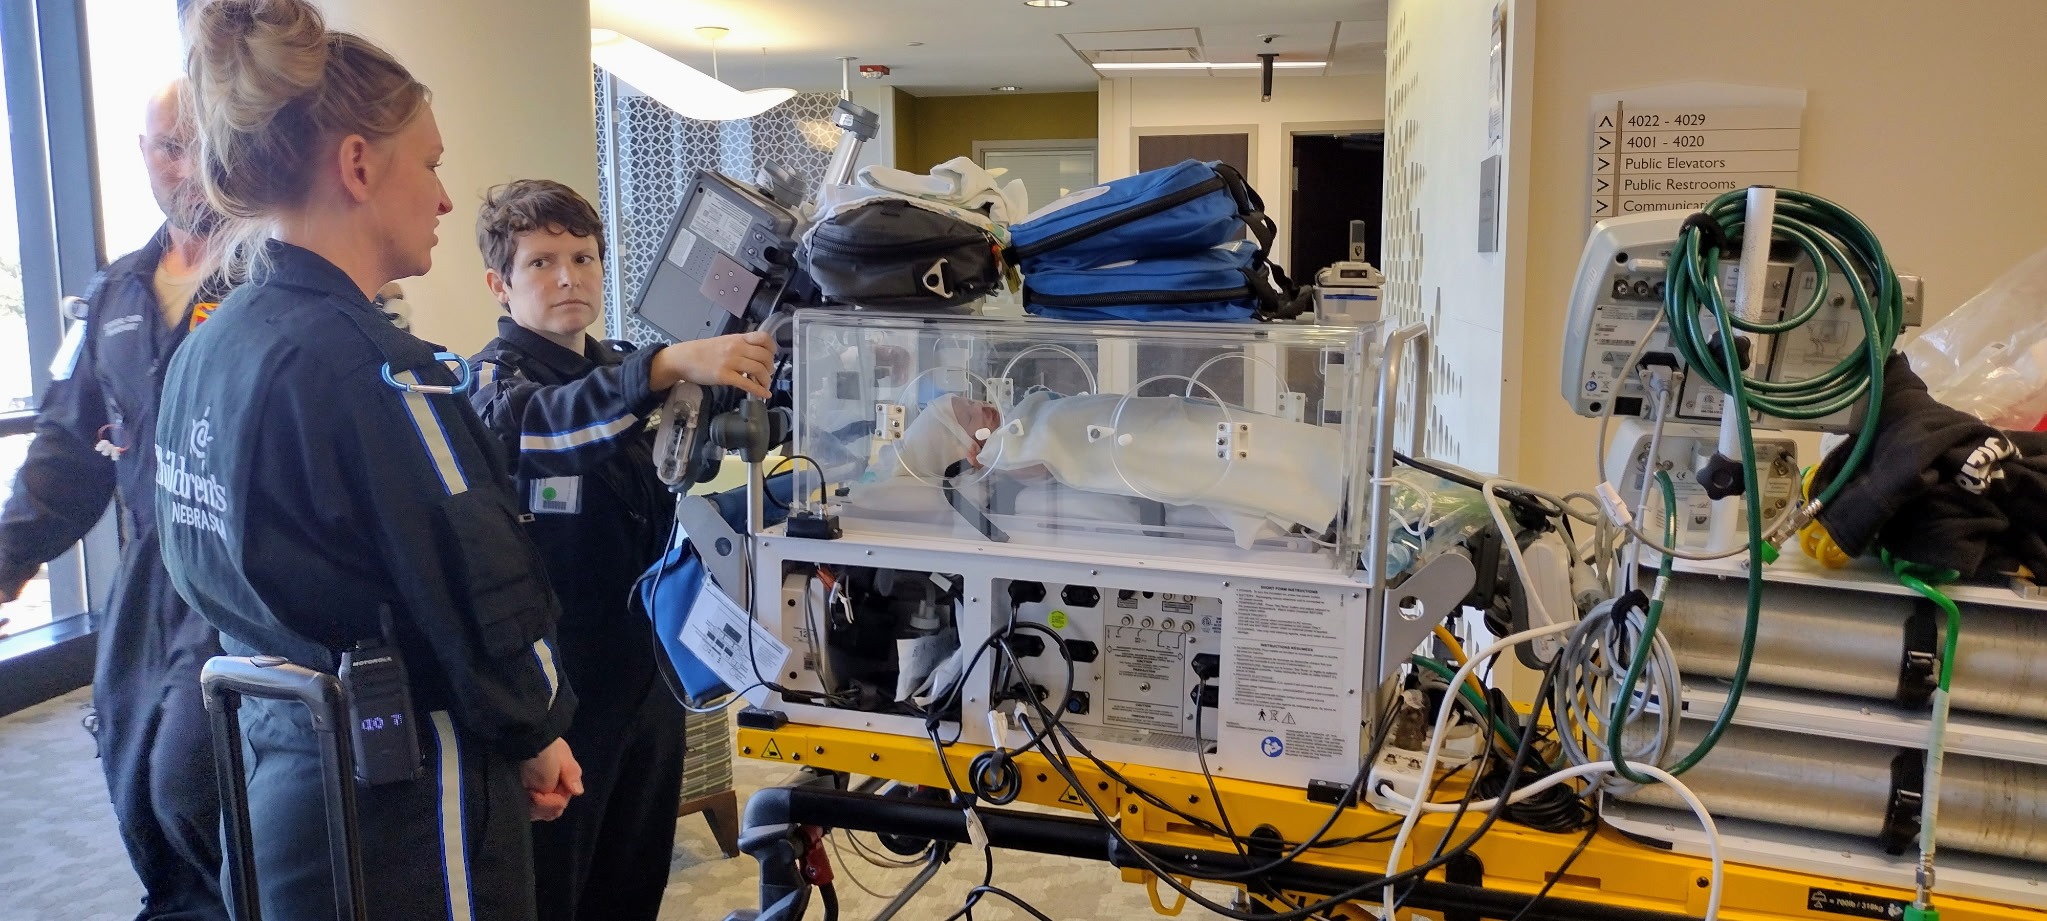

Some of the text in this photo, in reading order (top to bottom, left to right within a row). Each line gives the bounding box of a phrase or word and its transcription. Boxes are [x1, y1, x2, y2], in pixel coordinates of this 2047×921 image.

[1628, 115, 1660, 127] 4022
[1674, 114, 1706, 127] 4029
[1627, 136, 1656, 148] 4001
[1672, 135, 1705, 148] 4020
[1625, 157, 1726, 169] Public Elevators
[1624, 178, 1736, 191] Public Restrooms
